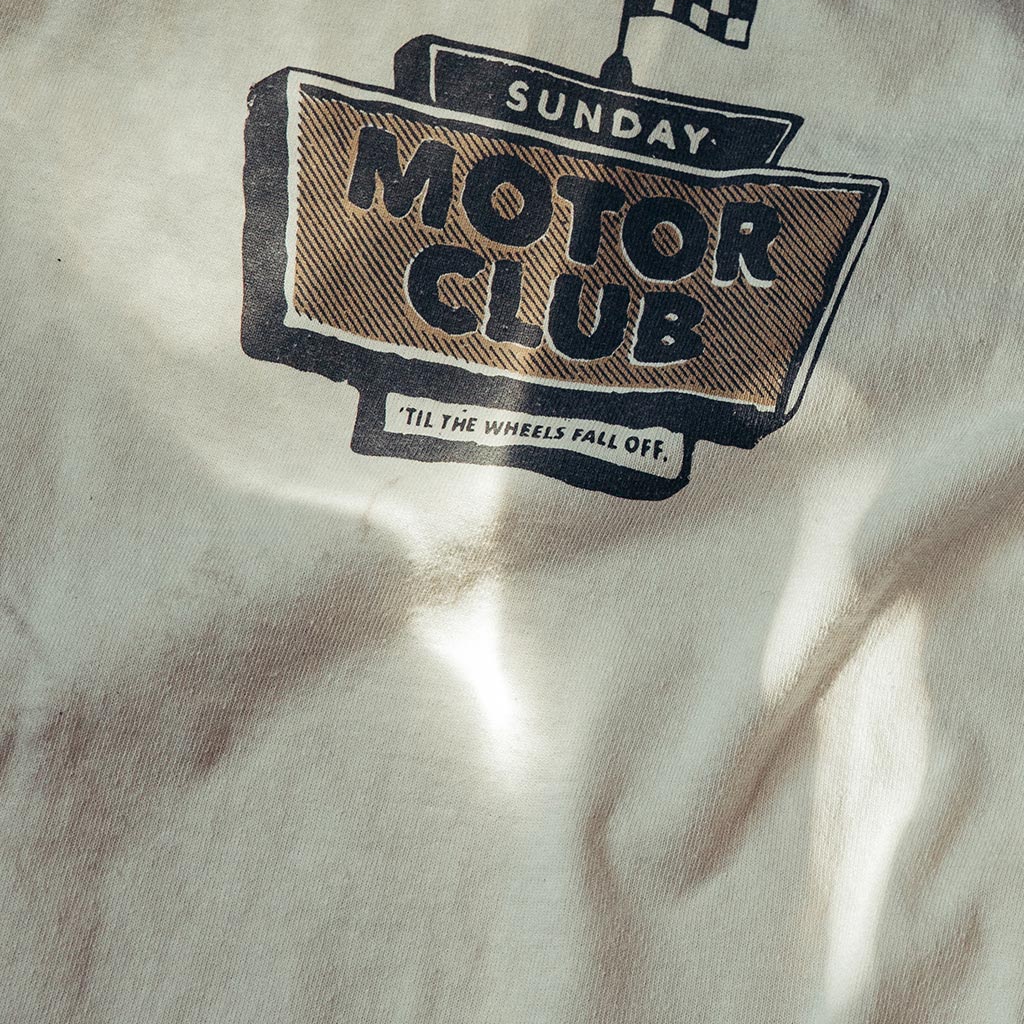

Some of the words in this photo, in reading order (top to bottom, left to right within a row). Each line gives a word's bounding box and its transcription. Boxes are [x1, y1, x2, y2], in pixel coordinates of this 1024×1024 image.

[506, 80, 710, 155] SUNDAY
[347, 126, 781, 287] MOTOR
[403, 244, 705, 366] CLUB
[441, 414, 478, 432] THE
[485, 420, 565, 440] WHEELS
[571, 428, 618, 450] FALL
[624, 436, 668, 463] OFF.
